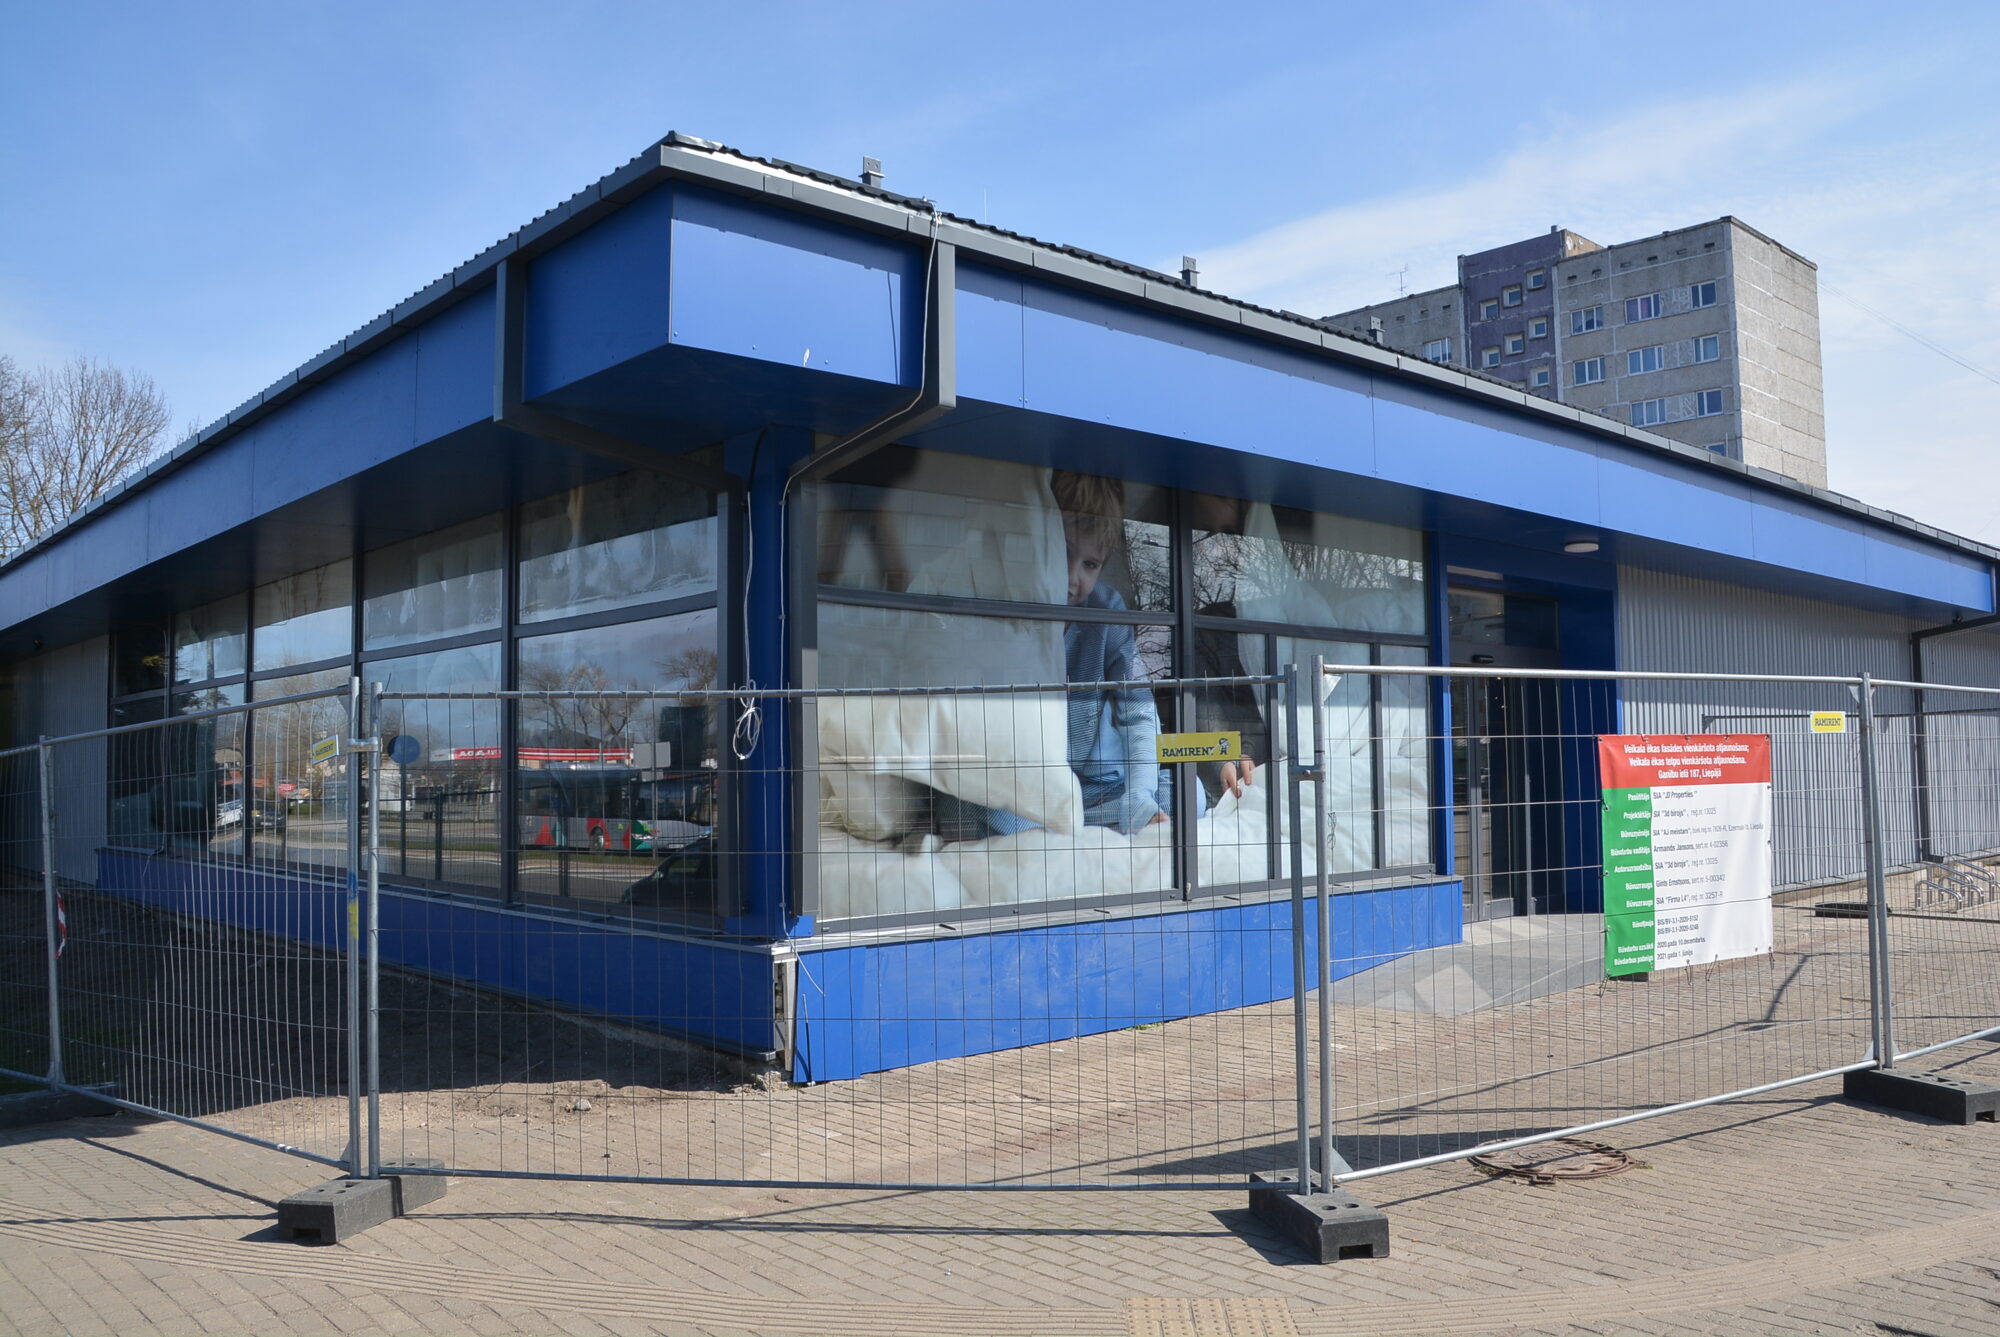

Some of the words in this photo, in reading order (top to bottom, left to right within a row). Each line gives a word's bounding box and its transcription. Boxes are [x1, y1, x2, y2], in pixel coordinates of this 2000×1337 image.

[1815, 718, 1841, 727] RAMIRENT
[1162, 746, 1214, 757] RAMIRENT
[1624, 744, 1645, 753] Veikala
[1662, 744, 1682, 752] fasādes
[1684, 744, 1715, 752] vienkāršota
[1629, 758, 1650, 766] Veikala
[1682, 756, 1712, 765] vienkāršota
[1658, 769, 1678, 779] Ganību
[1679, 769, 1688, 778] ielā
[1690, 769, 1701, 778] 187,
[1654, 844, 1675, 852] Armands
